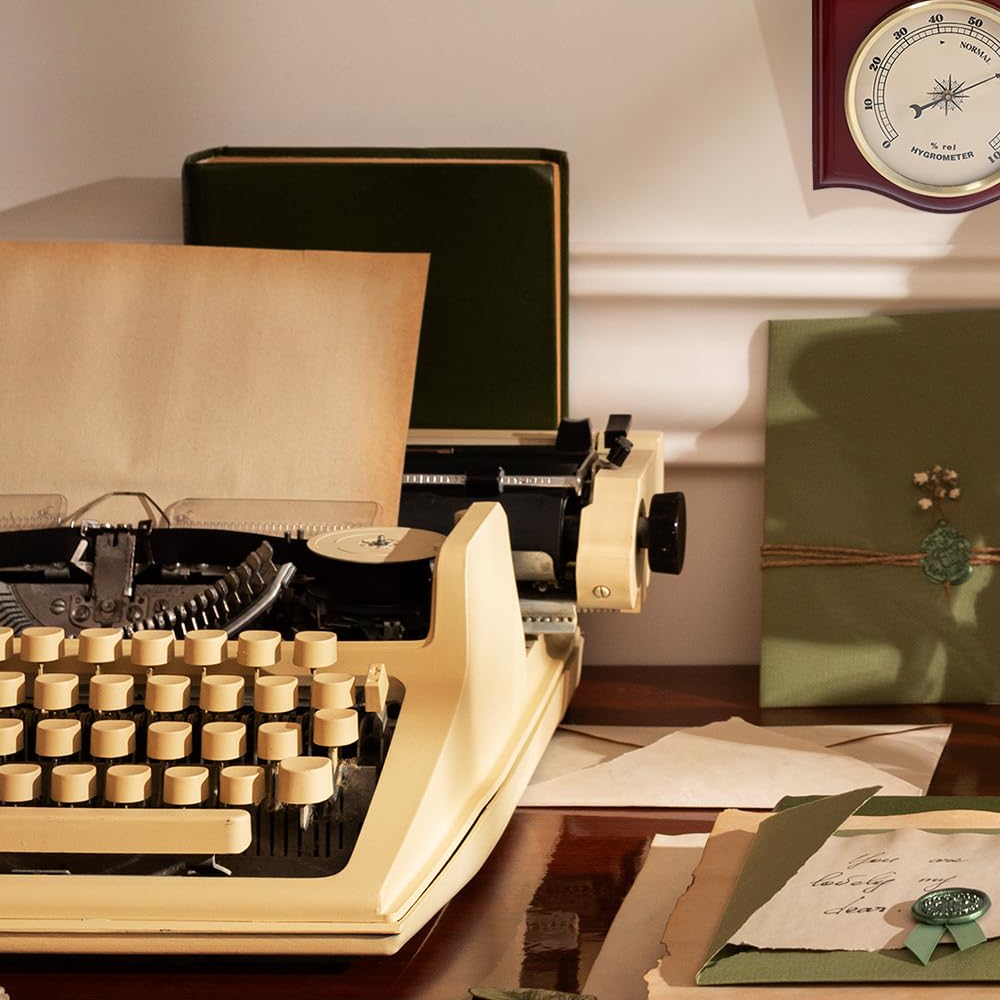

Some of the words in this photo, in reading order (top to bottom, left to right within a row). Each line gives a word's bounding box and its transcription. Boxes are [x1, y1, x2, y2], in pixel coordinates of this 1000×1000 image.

[928, 13, 944, 24] 40
[967, 16, 984, 28] 50
[892, 27, 908, 41] 30
[959, 40, 992, 65] NORMAL
[869, 56, 882, 72] 20
[864, 98, 873, 111] 10
[881, 140, 892, 149] 0
[930, 142, 939, 150] %
[942, 143, 956, 151] rel
[910, 146, 975, 162] HYGROMETER
[847, 851, 901, 870] You
[928, 856, 968, 864] are
[810, 871, 897, 894] lovely
[918, 875, 957, 893] my
